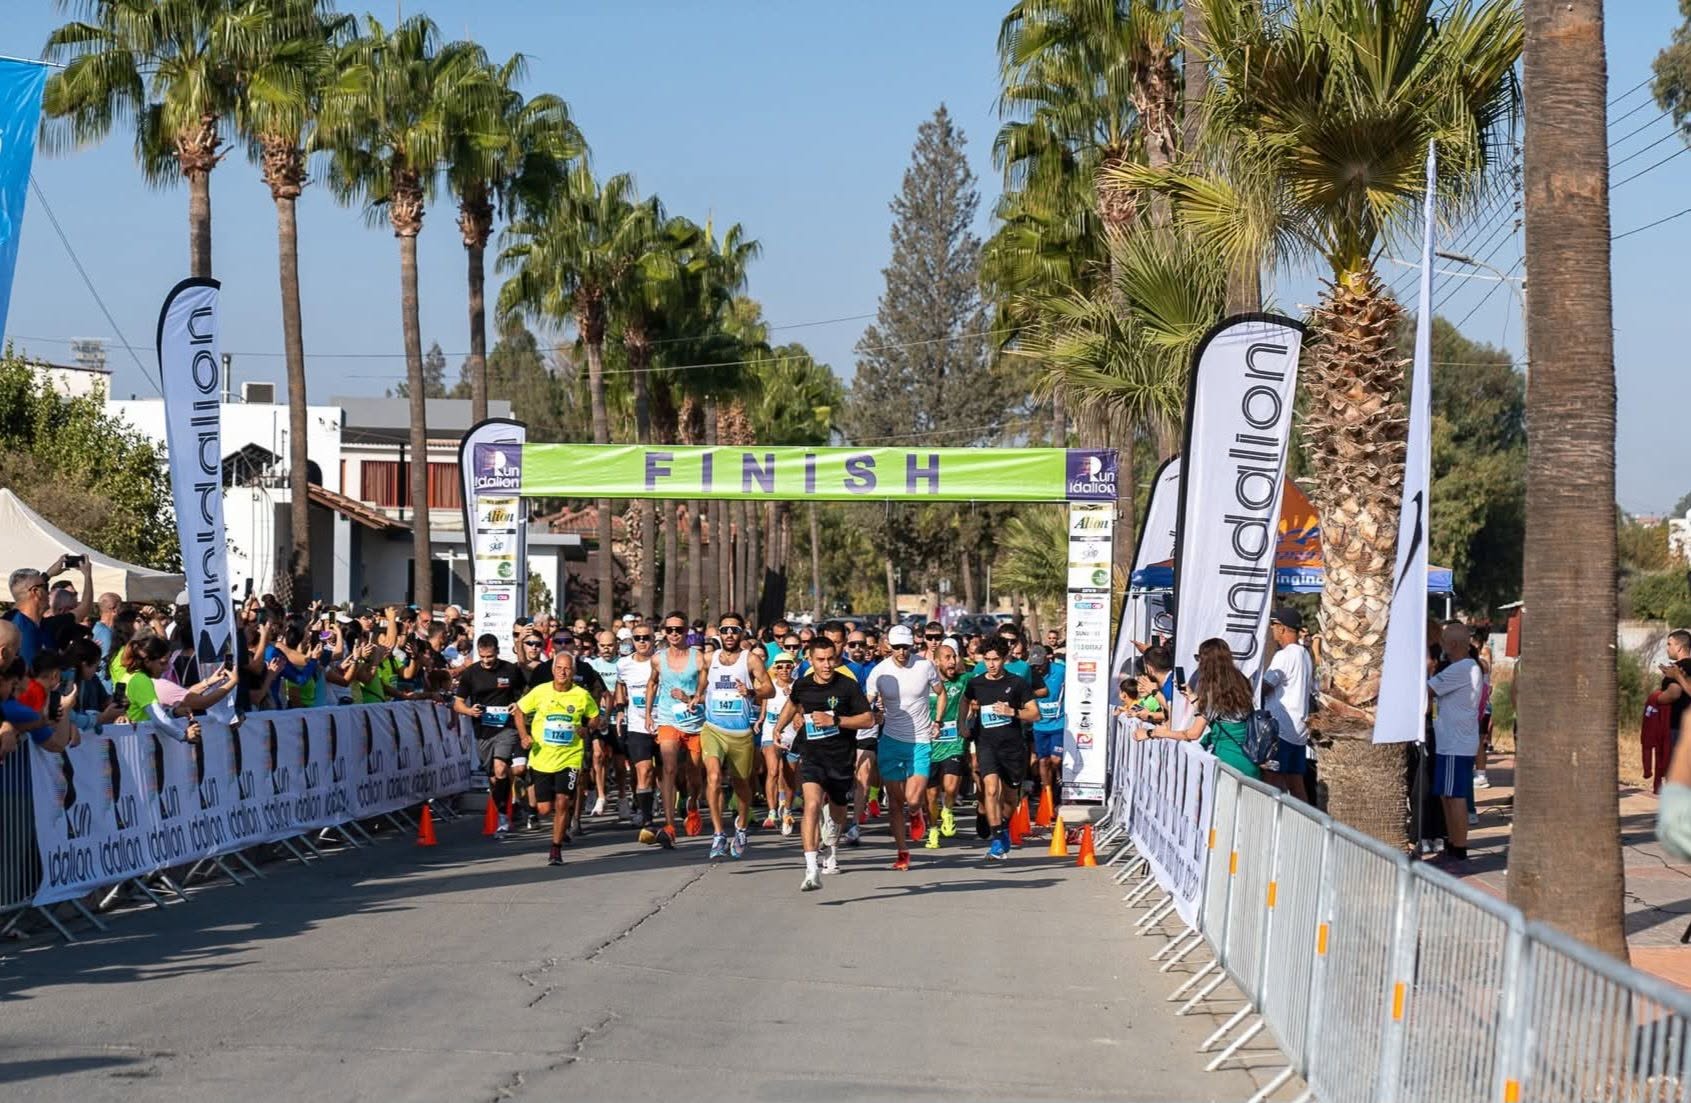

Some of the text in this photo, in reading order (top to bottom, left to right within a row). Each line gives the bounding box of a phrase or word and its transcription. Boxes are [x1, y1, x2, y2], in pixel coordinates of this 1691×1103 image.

[494, 451, 520, 476] Run
[644, 452, 940, 494] FINISH
[1090, 456, 1115, 482] Run
[1219, 343, 1288, 577] Idalion
[474, 476, 519, 489] Idalion
[1069, 482, 1116, 494] Idalion
[719, 700, 734, 710] 147
[551, 730, 566, 740] 174
[146, 823, 188, 863] Idalion
[187, 813, 227, 852] Idalion
[48, 843, 97, 888] Idalion
[98, 834, 145, 877] Idalion
